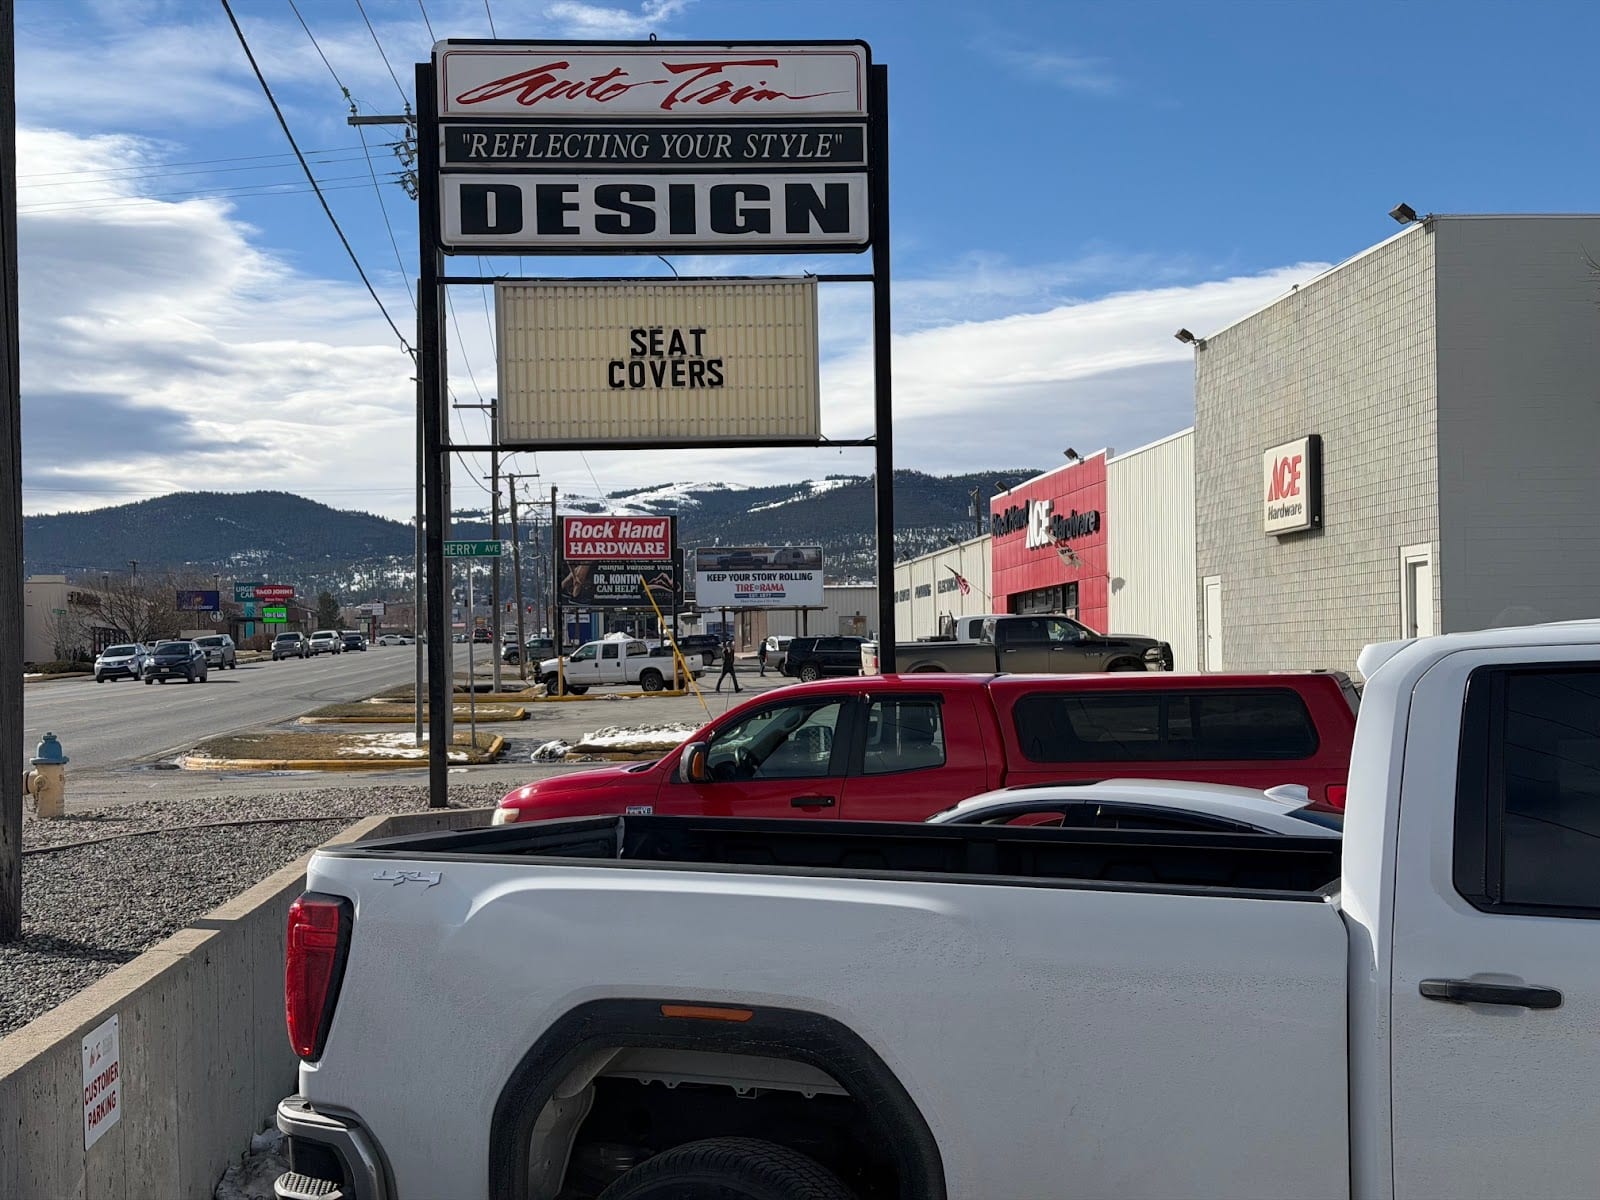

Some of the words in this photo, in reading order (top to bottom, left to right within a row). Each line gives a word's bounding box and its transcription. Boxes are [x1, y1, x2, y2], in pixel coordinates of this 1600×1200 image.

[456, 60, 668, 106] Auto
[660, 58, 850, 111] Trim
[462, 132, 650, 159] "REFLECTING
[660, 132, 733, 159] YOUR
[743, 132, 843, 159] STYLE"
[459, 183, 850, 235] DESIGN
[630, 329, 707, 356] SEAT
[608, 359, 724, 388] COVERS
[1267, 454, 1302, 502] ACE
[1025, 499, 1052, 549] ACE
[1052, 509, 1100, 540] Hardware
[1267, 502, 1302, 520] Hardware
[569, 521, 615, 539] Rock
[618, 521, 666, 539] Hand
[443, 544, 477, 555] HERRY
[485, 544, 499, 553] AVE
[569, 541, 666, 555] HARDWARE
[593, 574, 608, 585] DR.
[609, 573, 641, 585] KONTNY
[596, 584, 613, 593] CAN
[614, 584, 639, 593] HELP!
[707, 573, 727, 582] KEEP
[729, 573, 750, 582] YOUR
[752, 572, 778, 581] STORY
[779, 572, 813, 581] ROLLING
[84, 1060, 119, 1106] CUSTOMER
[87, 1090, 117, 1131] PARKING
